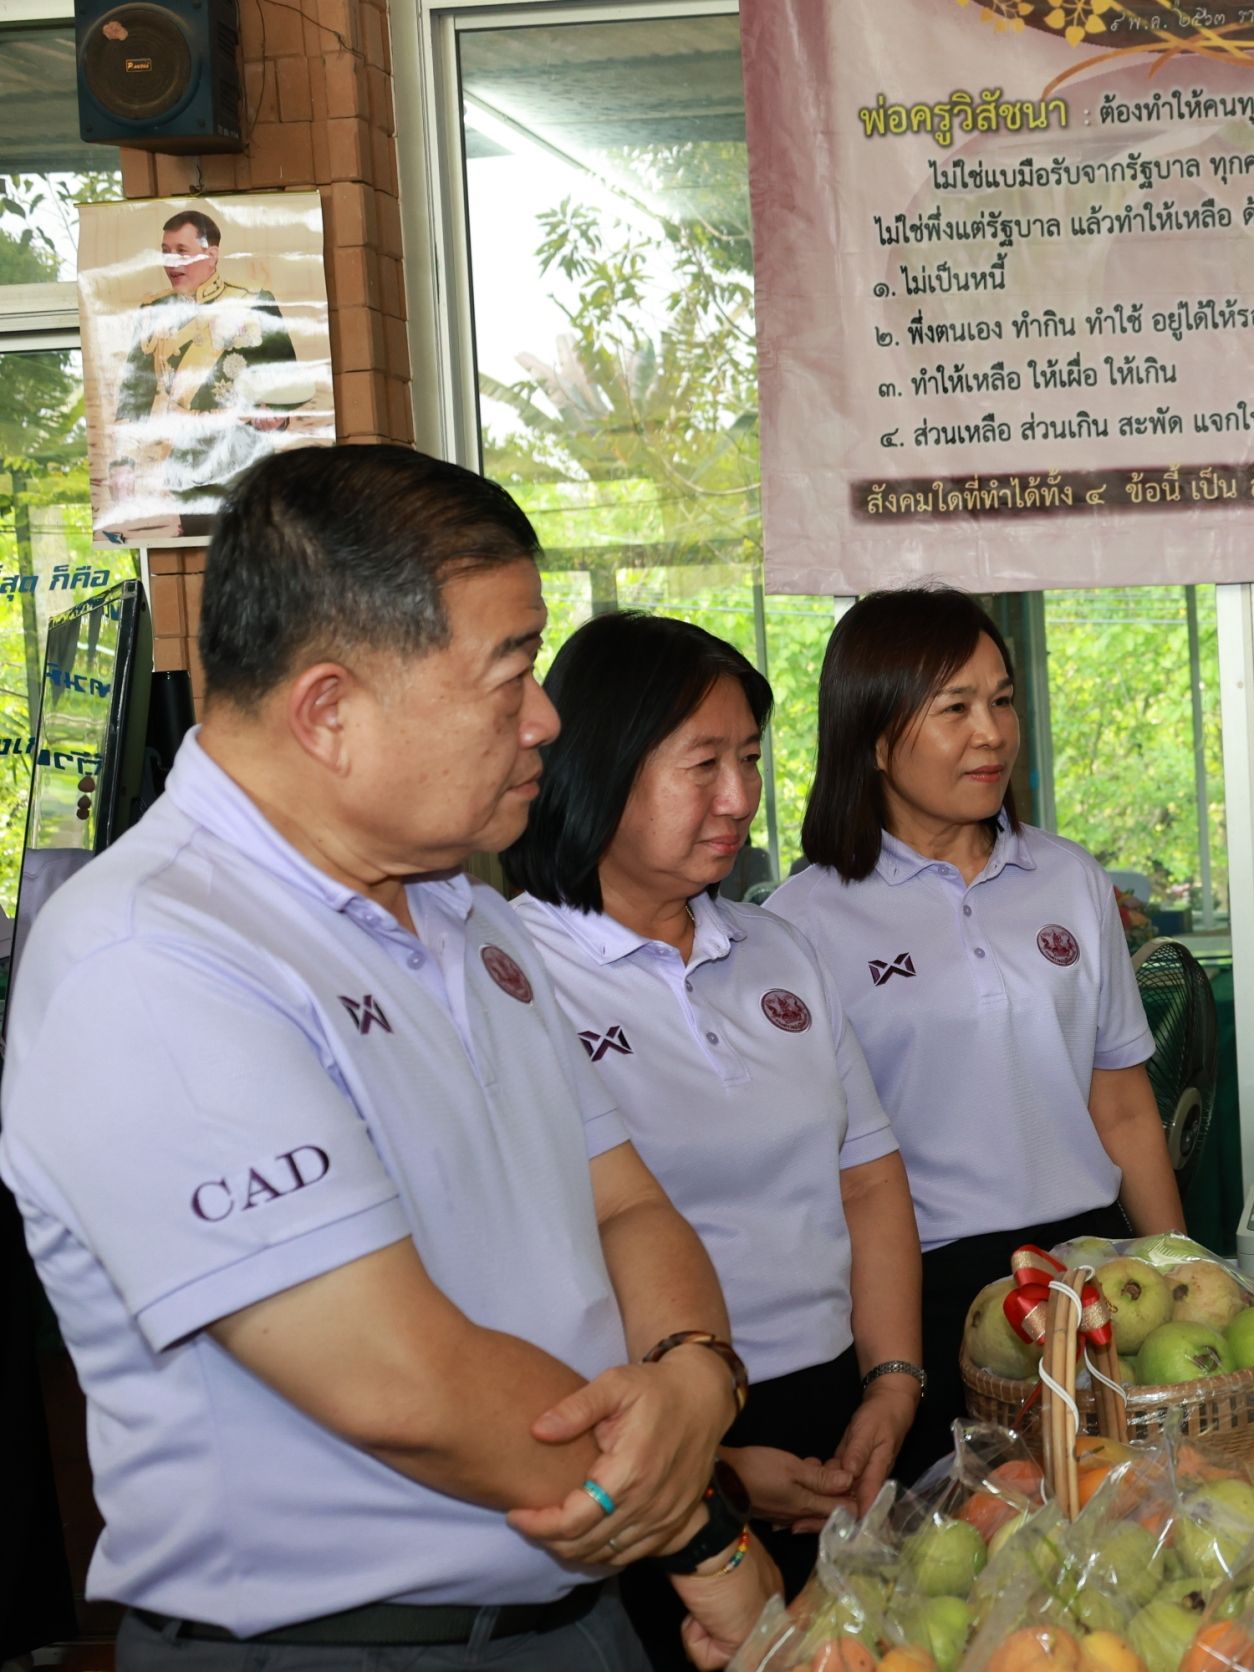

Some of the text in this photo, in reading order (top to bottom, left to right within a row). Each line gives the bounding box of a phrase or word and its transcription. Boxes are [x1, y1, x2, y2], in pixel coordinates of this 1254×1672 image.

[859, 88, 1068, 146] พ่อครูวิสัชนา
[928, 152, 1200, 190] ไม่ใช่แบมือรับจากรัฐบาล
[873, 205, 1061, 247] ไม่ใช่พึ่งแต่รัฐบาล
[1070, 198, 1232, 236] แล้วทำให้เหลือ
[873, 253, 1008, 298] ๑. ไม่เป็นหนี้
[875, 325, 900, 347] ๒.
[908, 309, 1003, 345] พึ่งตนเอง
[1012, 309, 1076, 339] ทำกิน
[1085, 303, 1143, 335] ทำใช้
[878, 352, 1177, 397] ๓. ทำให้เหลือ ให้เผื่อ ให้เกิน
[880, 428, 904, 448] ๔.
[914, 412, 1012, 447] ส่วนเหลือ
[1021, 410, 1109, 440] ส่วนเกิน
[1118, 406, 1183, 436] สะพัด
[866, 467, 1073, 514] สังคมใดที่ทำได้ทั้ง
[1125, 463, 1181, 502] ข้อนี้
[1191, 466, 1238, 501] เป็น
[49, 565, 110, 590] ก็คือ
[191, 1145, 330, 1223] CAD
